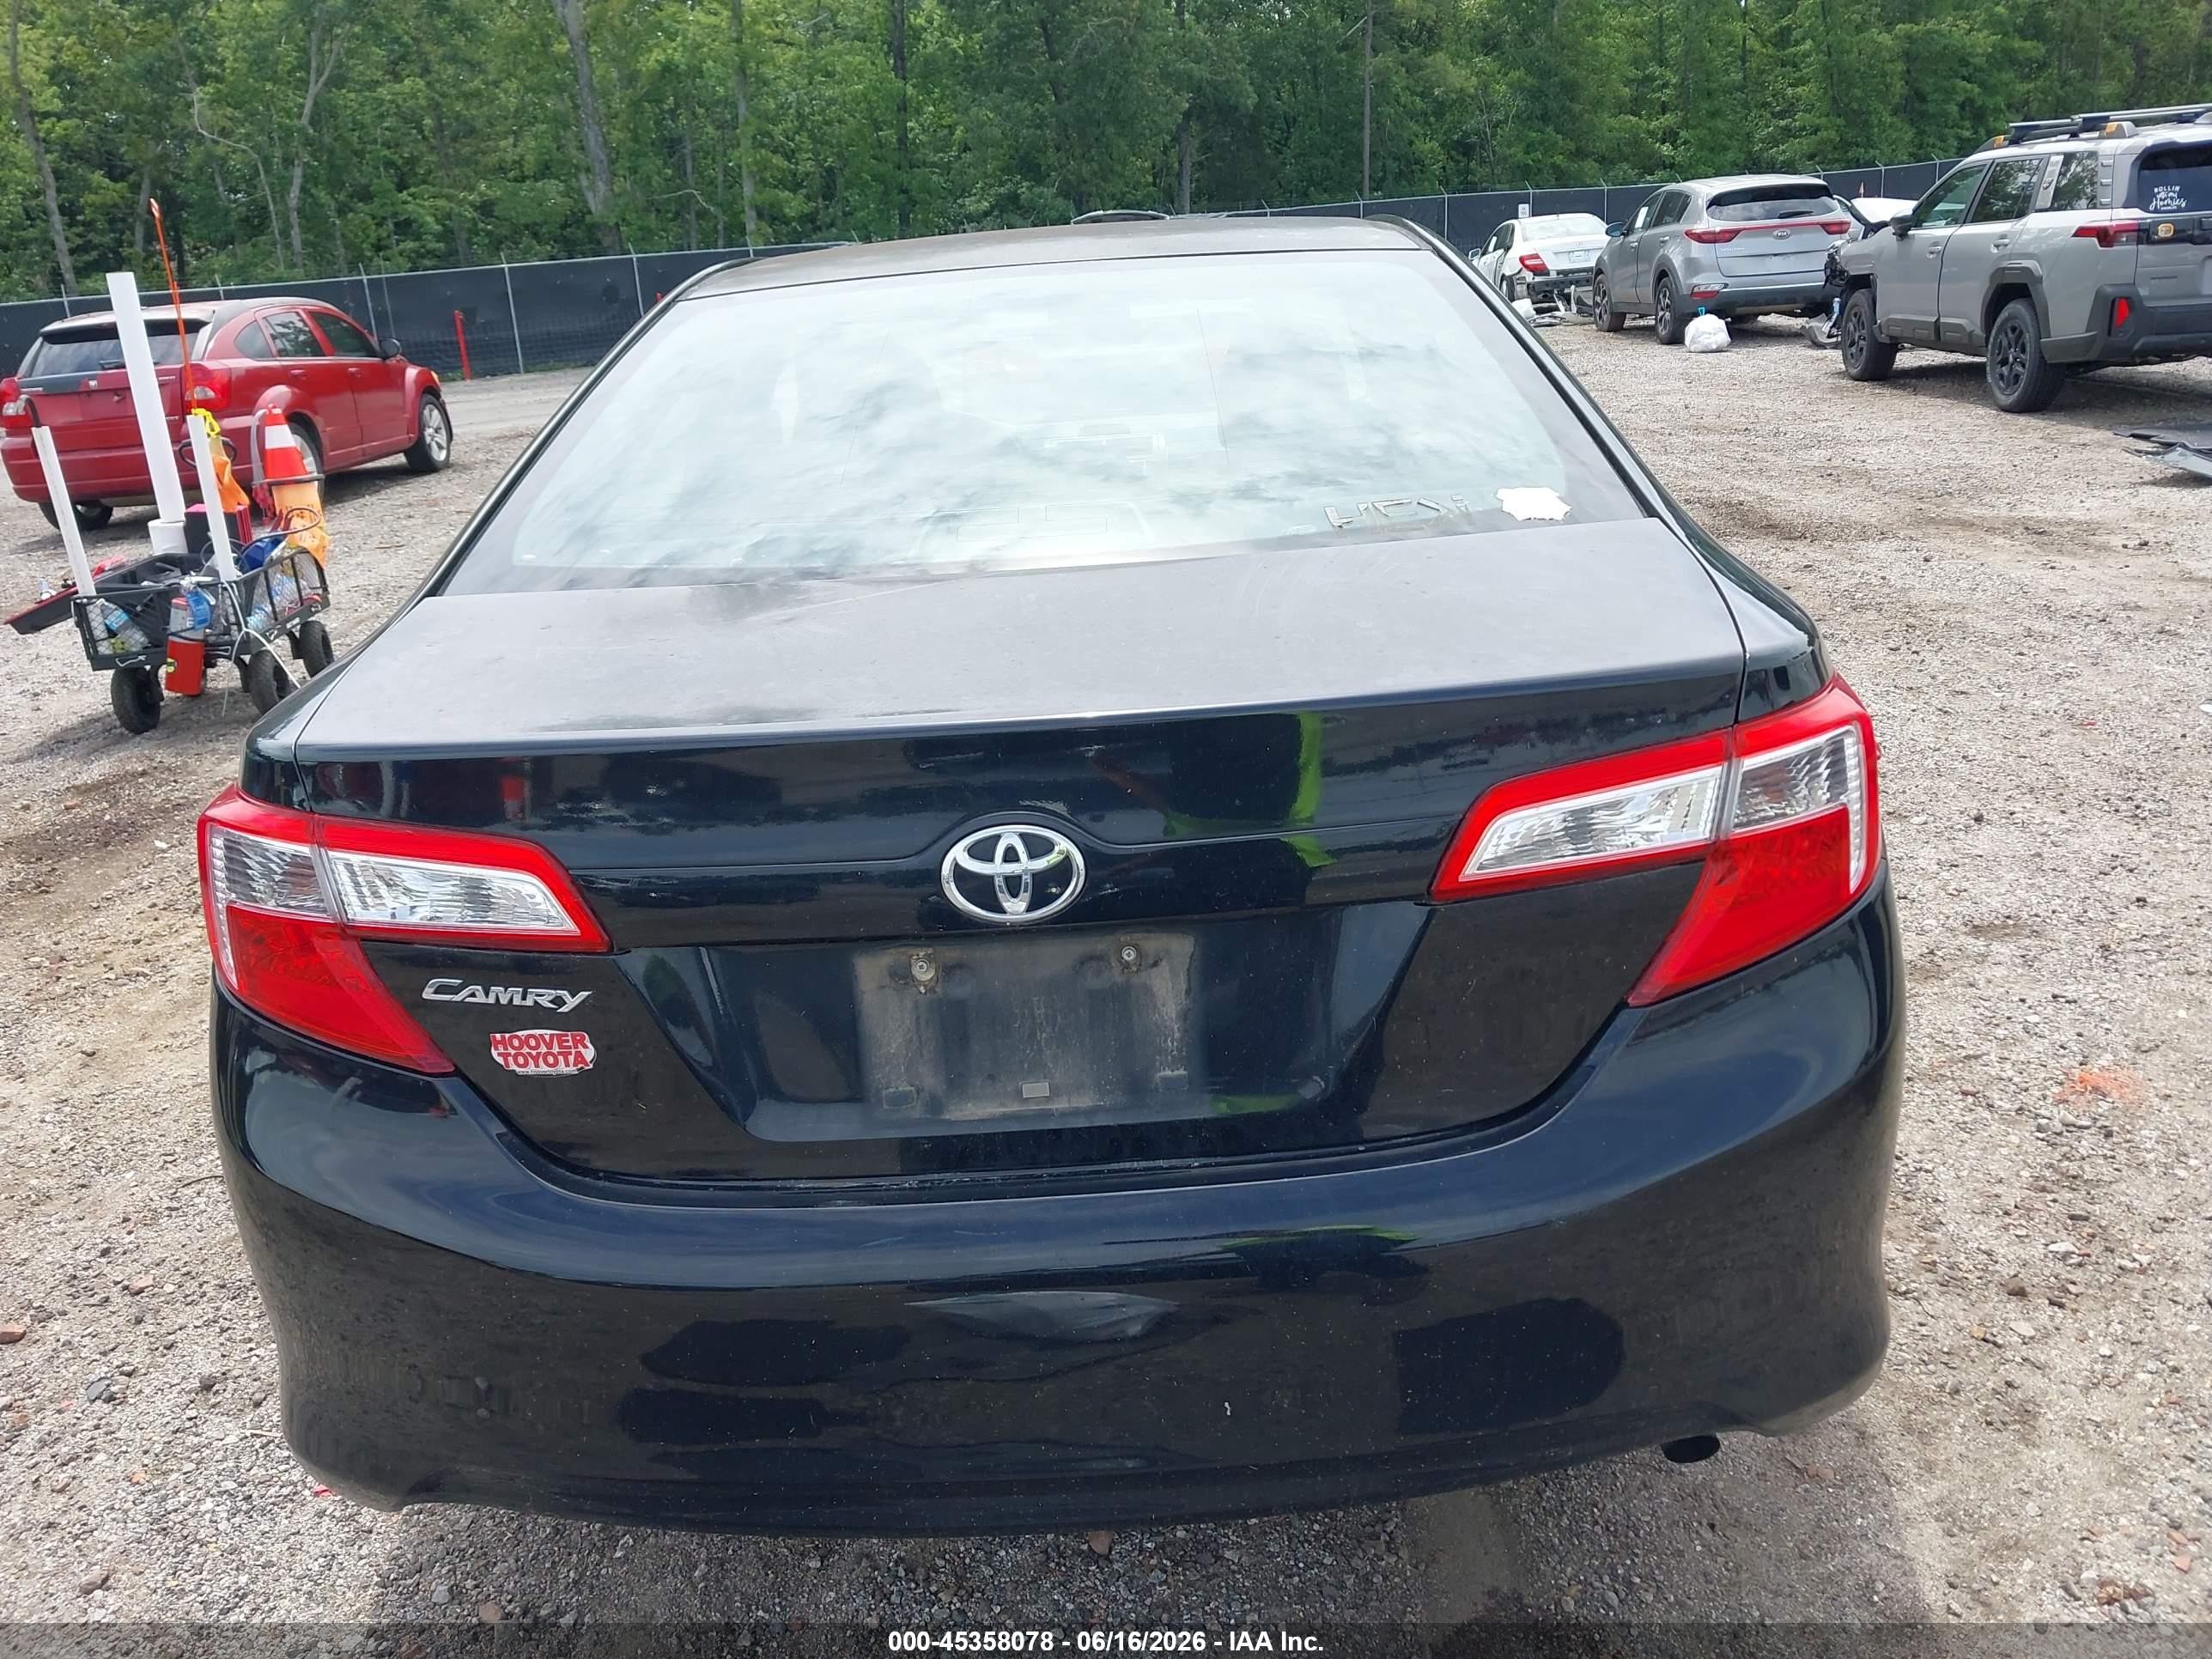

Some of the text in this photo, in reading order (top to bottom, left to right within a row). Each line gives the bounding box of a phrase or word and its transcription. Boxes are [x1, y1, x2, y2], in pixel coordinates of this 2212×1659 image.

[2149, 198, 2188, 210] Homies
[422, 978, 592, 1012] CAMRY
[490, 1032, 589, 1052] HOOVER
[497, 1050, 591, 1069] TOYOTA
